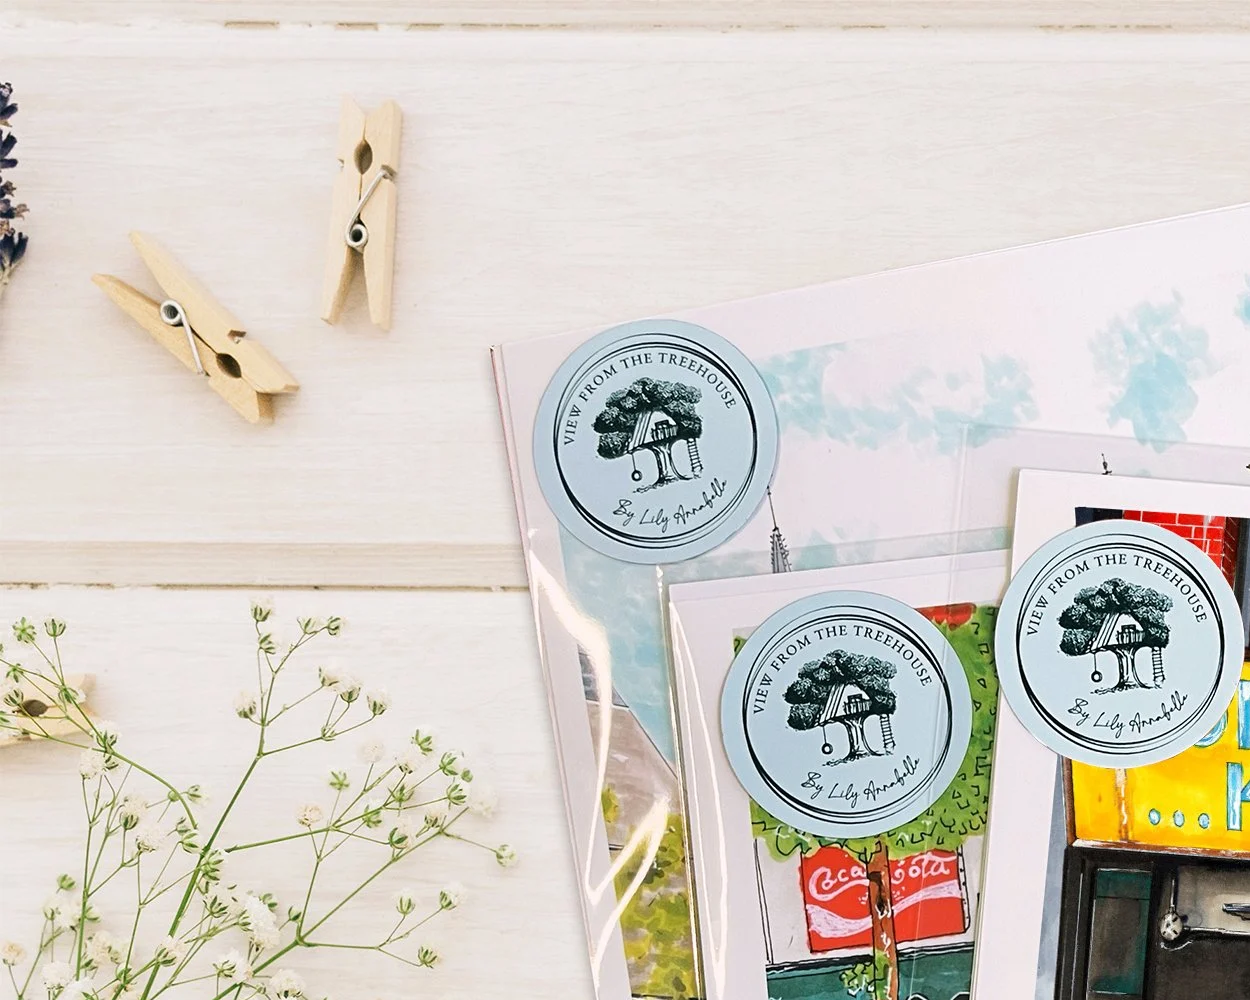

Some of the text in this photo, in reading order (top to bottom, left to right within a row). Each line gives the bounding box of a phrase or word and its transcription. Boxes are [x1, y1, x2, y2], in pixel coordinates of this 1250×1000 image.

[563, 352, 737, 446] VIEW FROM THE TREEHOUSE
[612, 477, 728, 533] By Lily Annabelle
[1026, 553, 1208, 637] VIEW FROM THE TREEHOUSE
[753, 624, 933, 715] VIEW FROM THE TREEHOUSE
[1067, 690, 1188, 739] By Lily Annabelle
[800, 754, 921, 809] By Lily Annabelle
